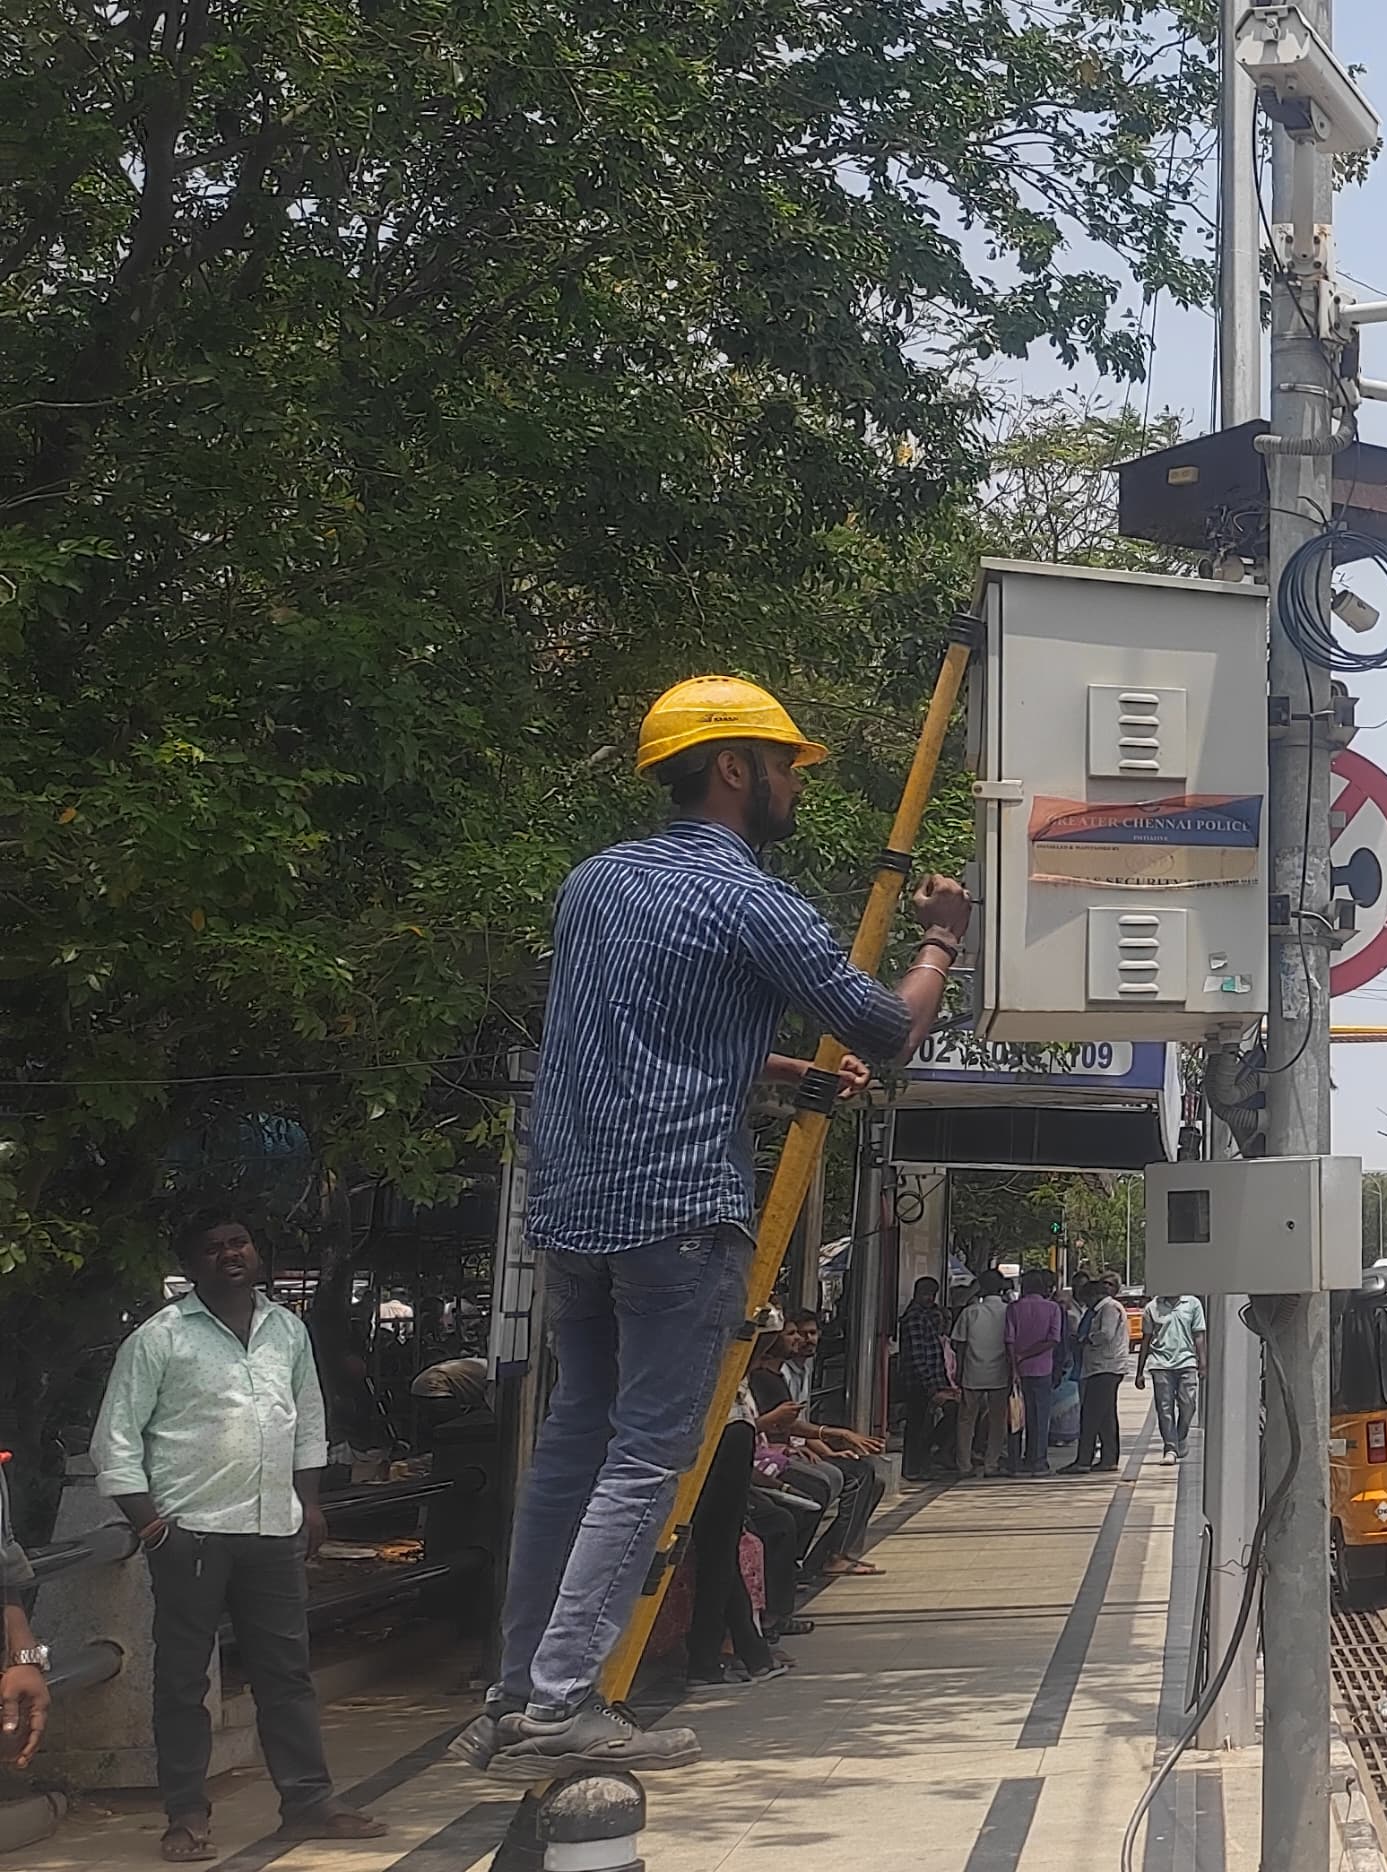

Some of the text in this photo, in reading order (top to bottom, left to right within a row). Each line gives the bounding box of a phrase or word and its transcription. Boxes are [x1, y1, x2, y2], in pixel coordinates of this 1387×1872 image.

[1046, 815, 1251, 832] GREATER CHENNAI POLICE
